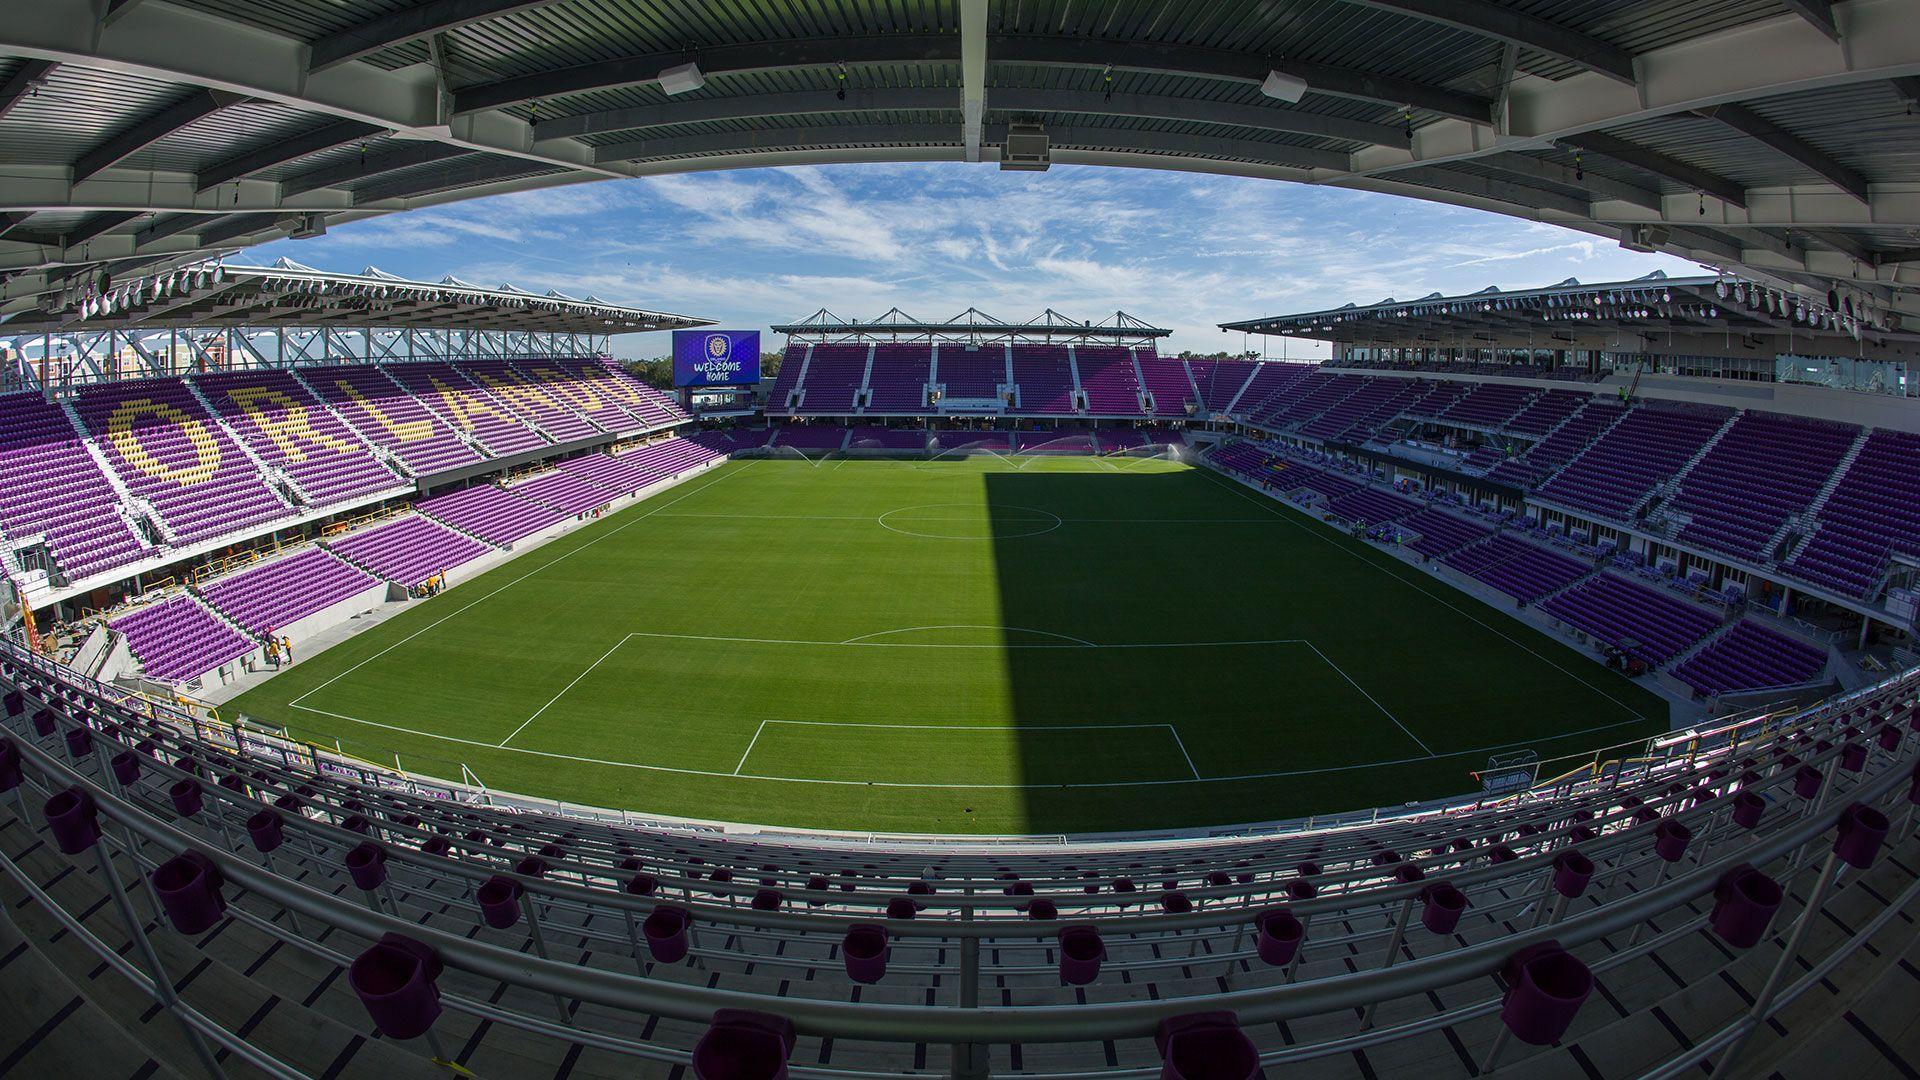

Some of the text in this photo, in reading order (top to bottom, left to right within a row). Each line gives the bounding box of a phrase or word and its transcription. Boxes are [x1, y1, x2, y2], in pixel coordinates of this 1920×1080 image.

[694, 361, 741, 371] WELCOME
[706, 371, 729, 381] HOME
[108, 366, 642, 487] ORLANDO
